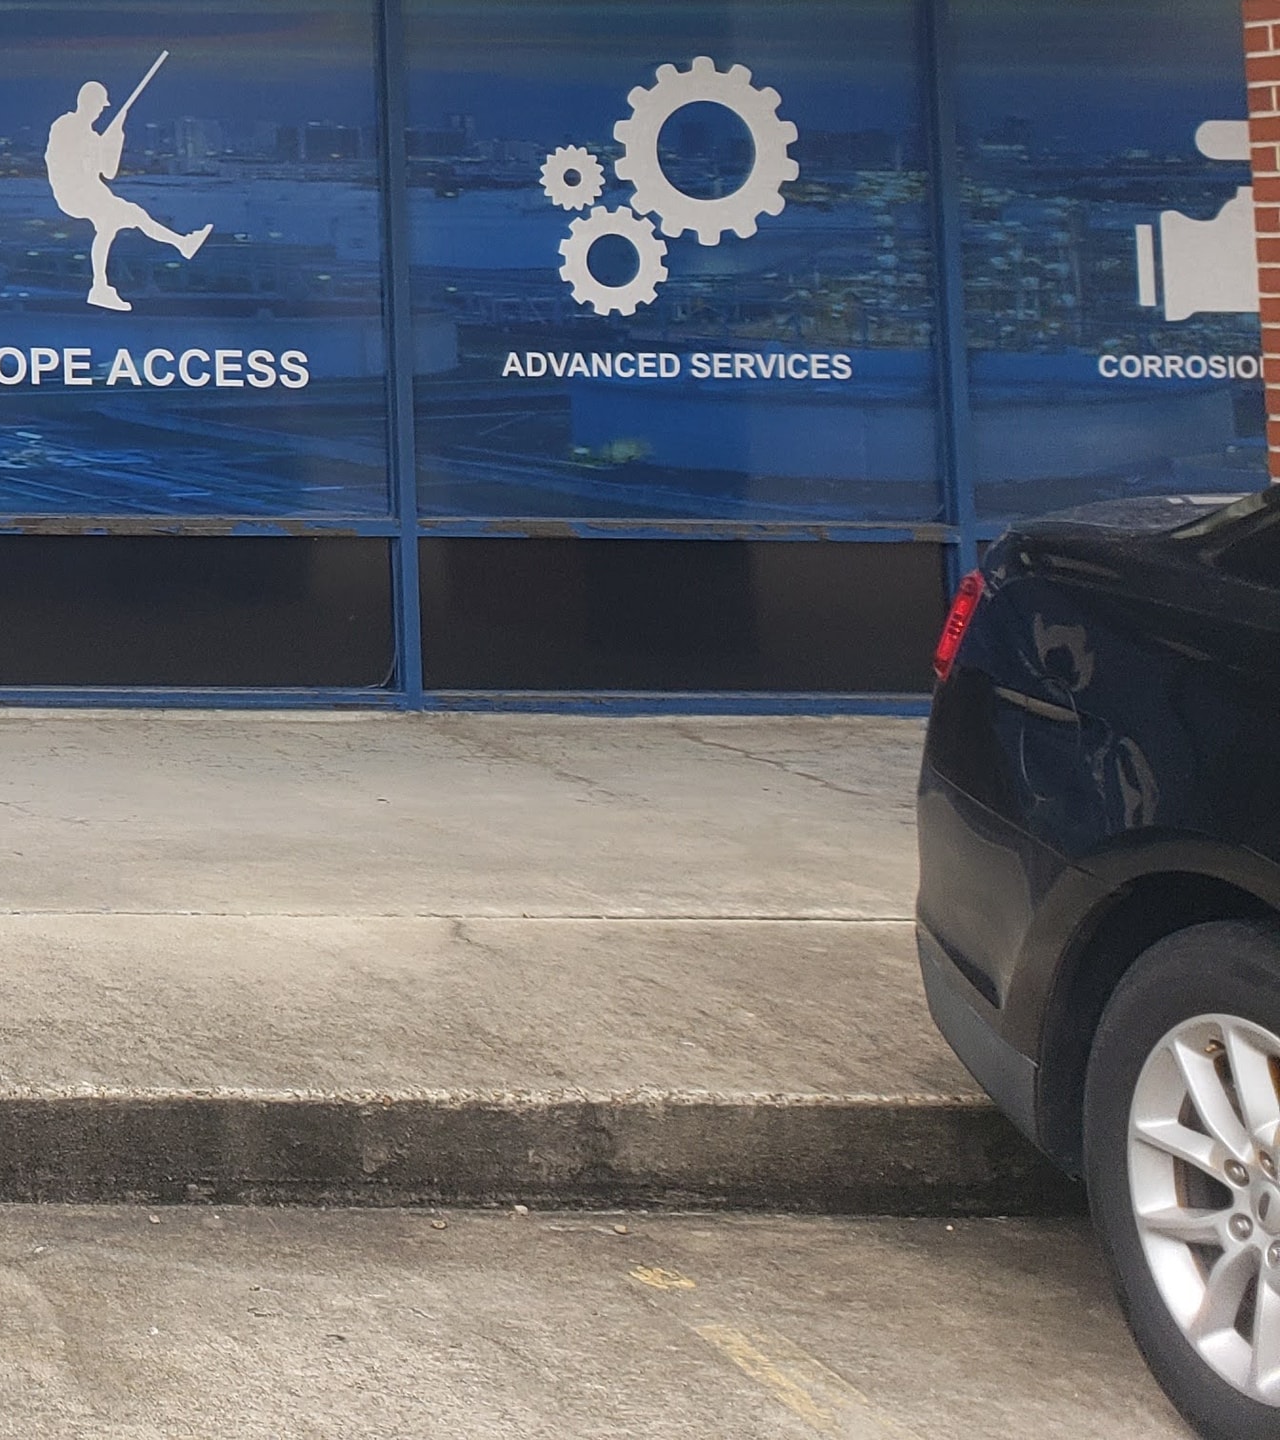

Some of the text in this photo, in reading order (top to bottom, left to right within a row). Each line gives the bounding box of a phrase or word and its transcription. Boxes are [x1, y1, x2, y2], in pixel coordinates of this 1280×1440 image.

[106, 348, 310, 389] ACCESS
[501, 351, 852, 380] ADVANCED SERVICES
[1097, 354, 1264, 379] CORROSIO
